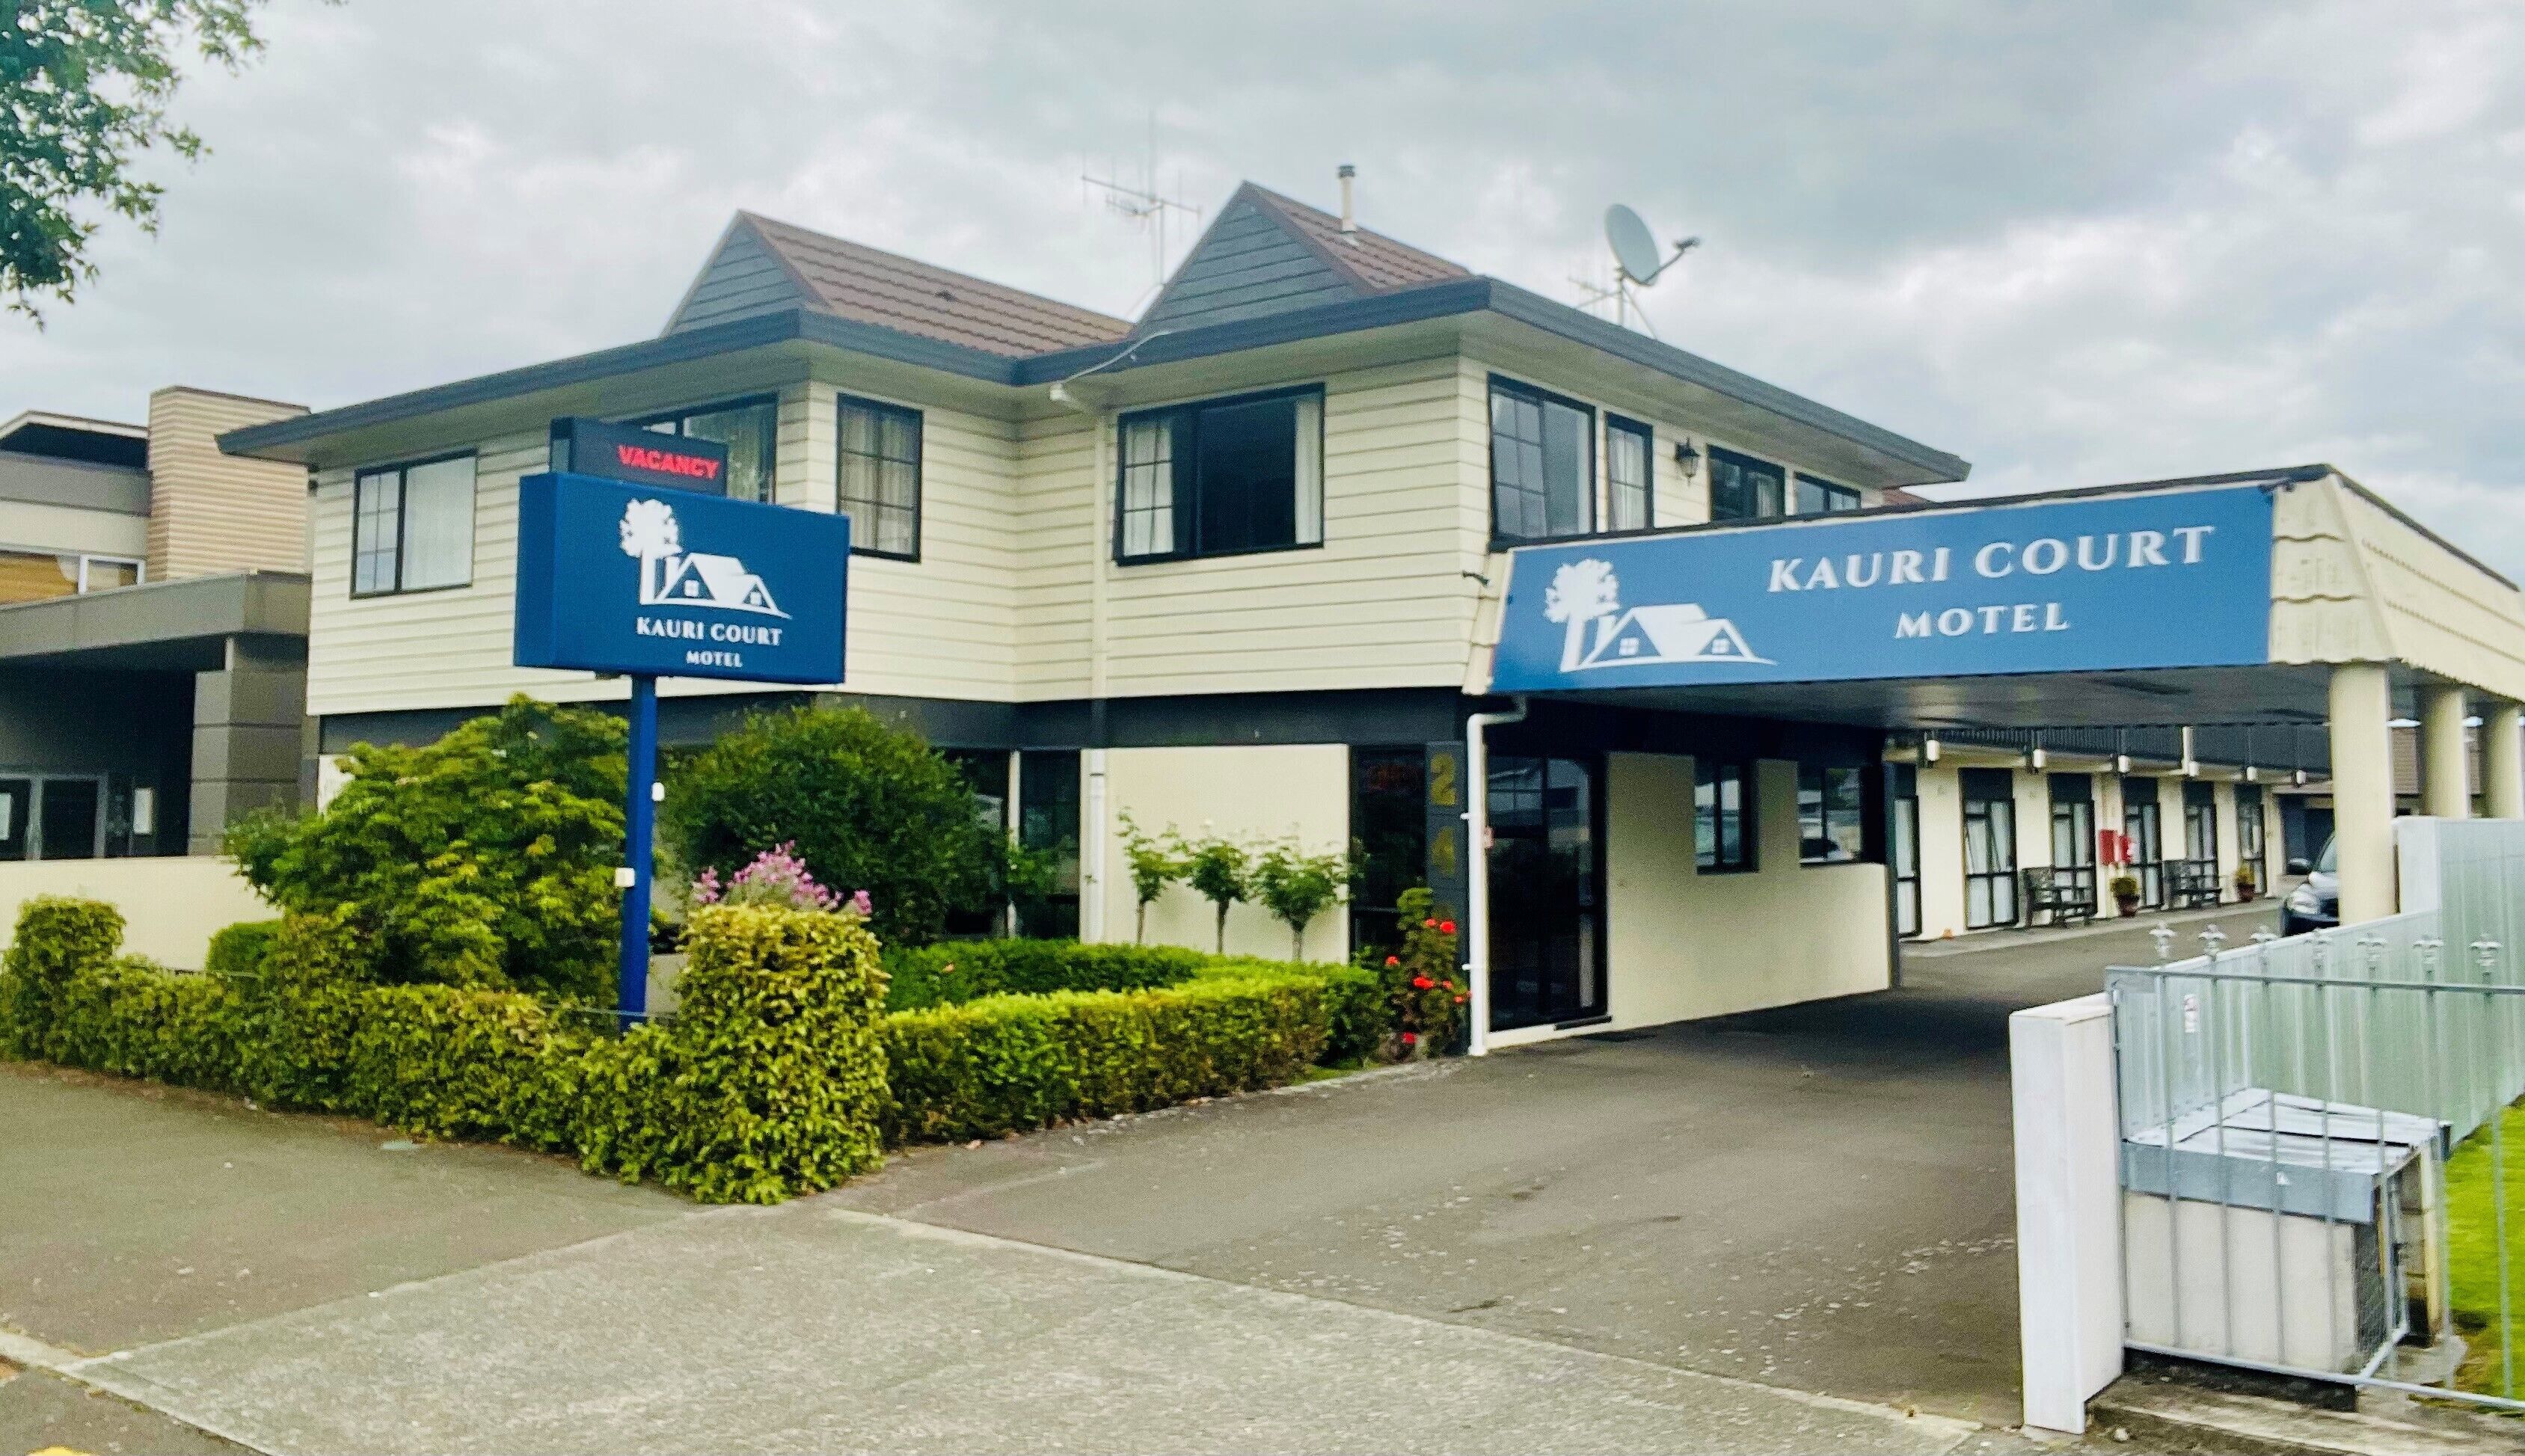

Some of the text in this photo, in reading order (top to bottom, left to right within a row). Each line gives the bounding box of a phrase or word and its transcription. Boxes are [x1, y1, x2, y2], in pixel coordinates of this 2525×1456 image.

[619, 445, 720, 479] VACANCY
[1767, 526, 2215, 593] KAURI COURT
[636, 616, 784, 646] KAURI COURT
[1894, 602, 2071, 639] MOTEL
[685, 650, 743, 668] MOTEL
